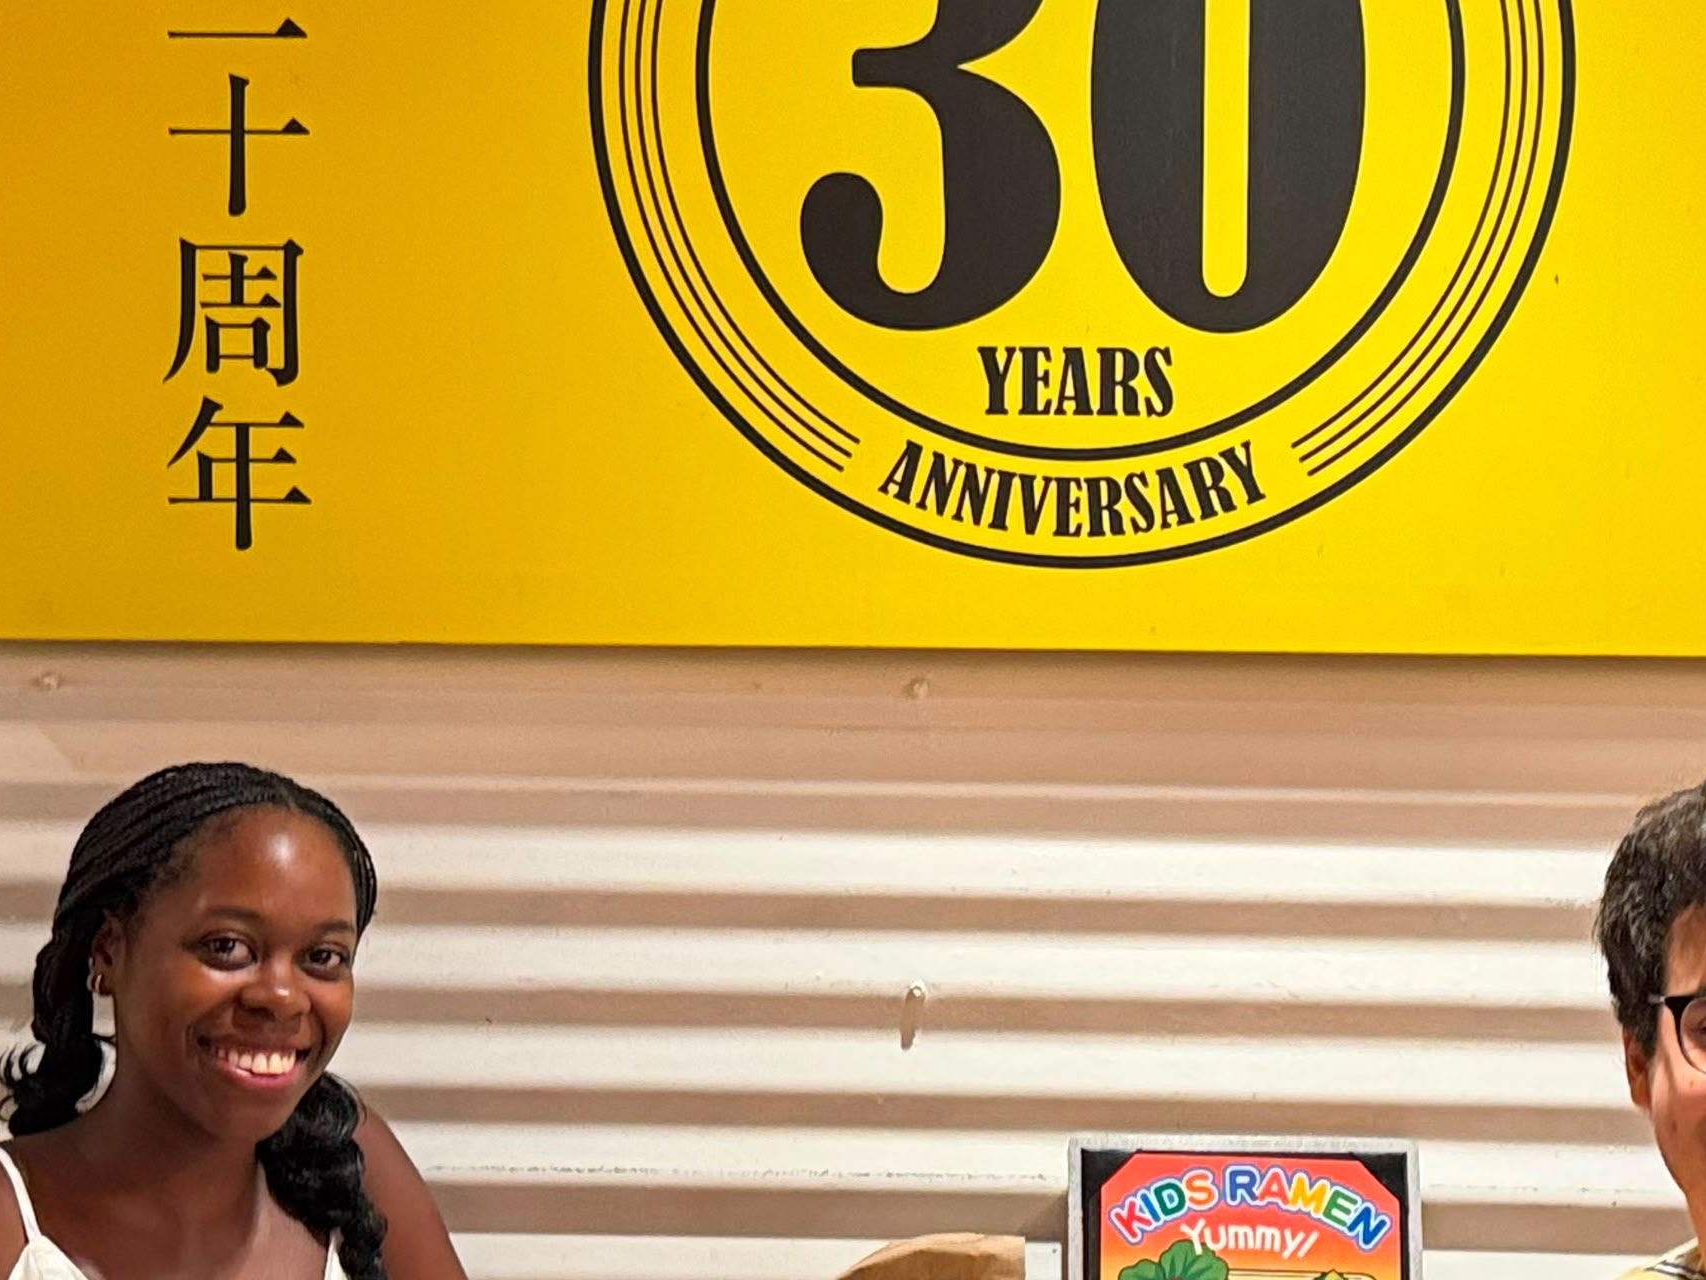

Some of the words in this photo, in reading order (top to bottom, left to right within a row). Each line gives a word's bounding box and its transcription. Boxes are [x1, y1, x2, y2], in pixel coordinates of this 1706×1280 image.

[977, 346, 1174, 417] YEARS
[877, 438, 1267, 538] ANNIVERSARY
[1110, 1169, 1219, 1245] KIDS
[1224, 1164, 1391, 1253] RAMEN
